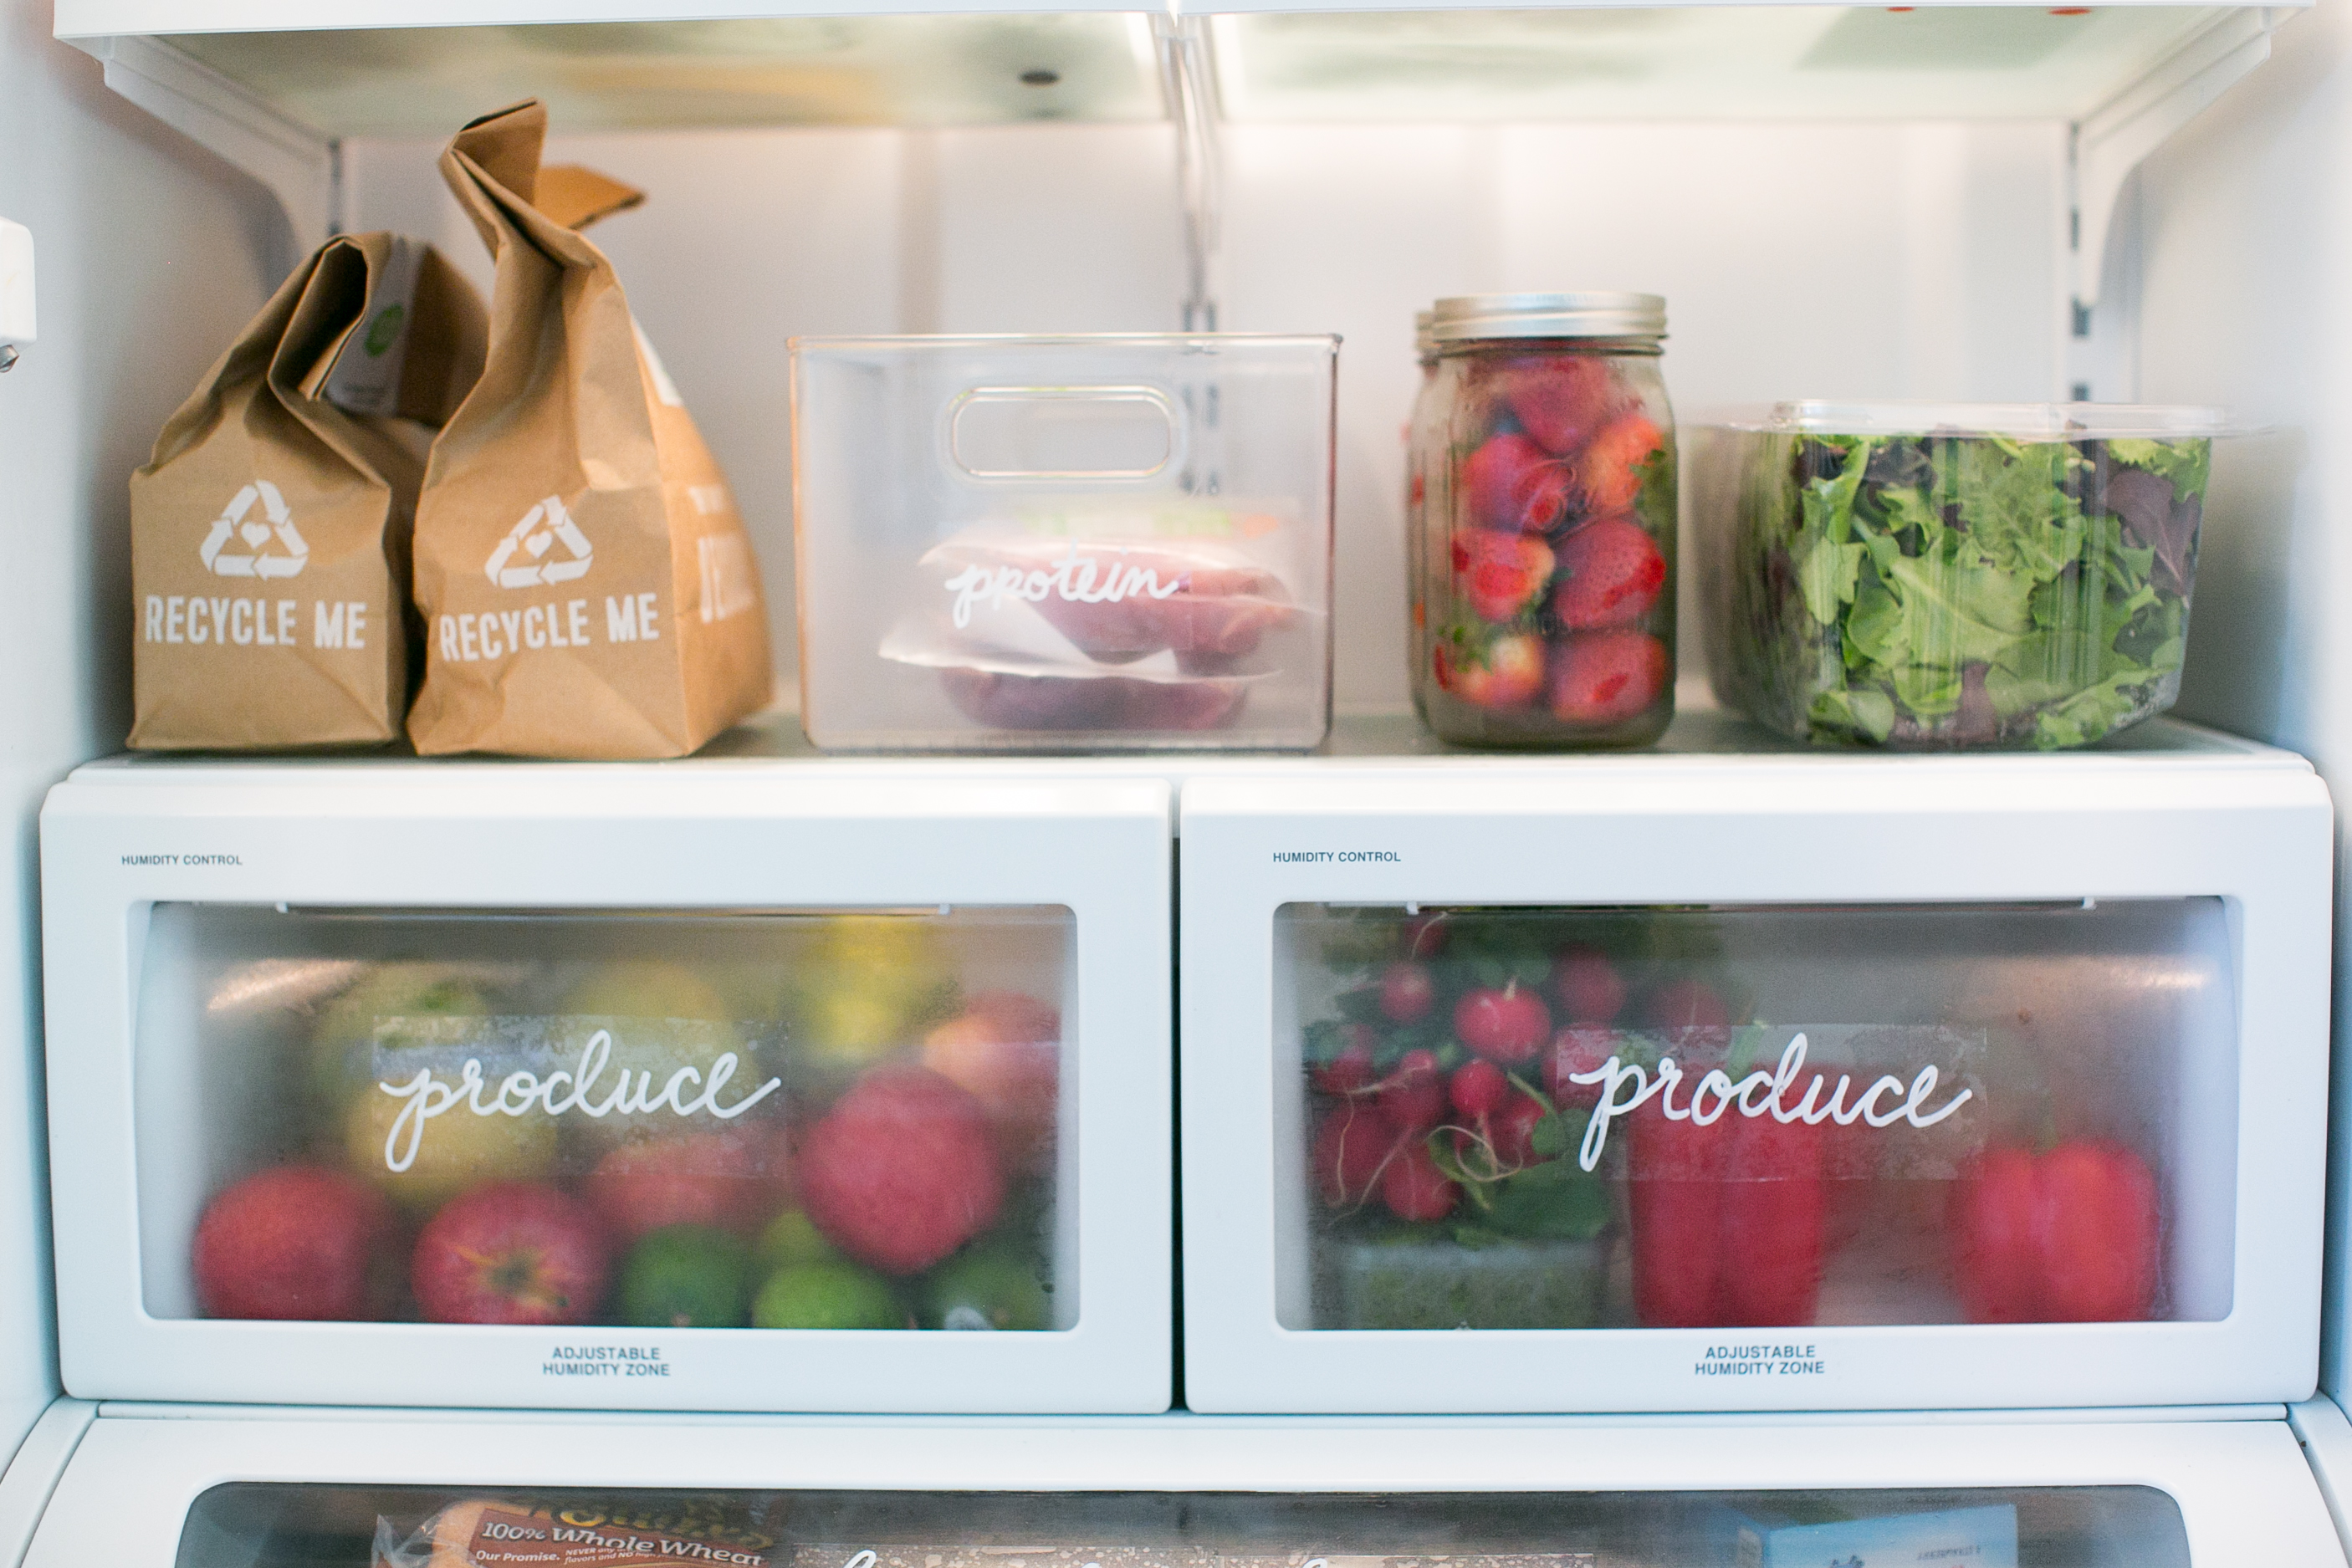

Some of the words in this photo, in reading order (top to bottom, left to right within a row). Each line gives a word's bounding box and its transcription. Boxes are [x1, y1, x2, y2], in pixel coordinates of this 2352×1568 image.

[945, 538, 1180, 629] protein
[144, 595, 297, 646] RECYCLE
[314, 600, 367, 650] ME
[439, 599, 591, 662] RECYCLE
[606, 592, 660, 643] ME
[121, 855, 179, 866] HUMIDITY
[183, 855, 243, 866] CONTROL
[1273, 851, 1334, 863] HUMIDITY
[1337, 851, 1401, 862] CONTROL
[379, 1029, 782, 1172] produce
[1568, 1032, 1973, 1172] produce
[552, 1346, 661, 1360] ADJUSTABLE
[1705, 1345, 1817, 1360] ADJUSTABLE
[543, 1363, 621, 1376] HUMIDITY
[626, 1364, 671, 1376] ZONE
[1695, 1362, 1775, 1376] HUMIDITY
[1779, 1361, 1826, 1375] ZONE
[482, 1520, 547, 1541] 100%
[552, 1527, 655, 1553] Whole
[659, 1539, 764, 1566] Wheat
[475, 1550, 500, 1562] Our
[502, 1552, 560, 1563] Promise.
[563, 1555, 596, 1566] flavors
[597, 1552, 617, 1561] and
[617, 1550, 635, 1560] NO
[565, 1547, 596, 1556] NEVER
